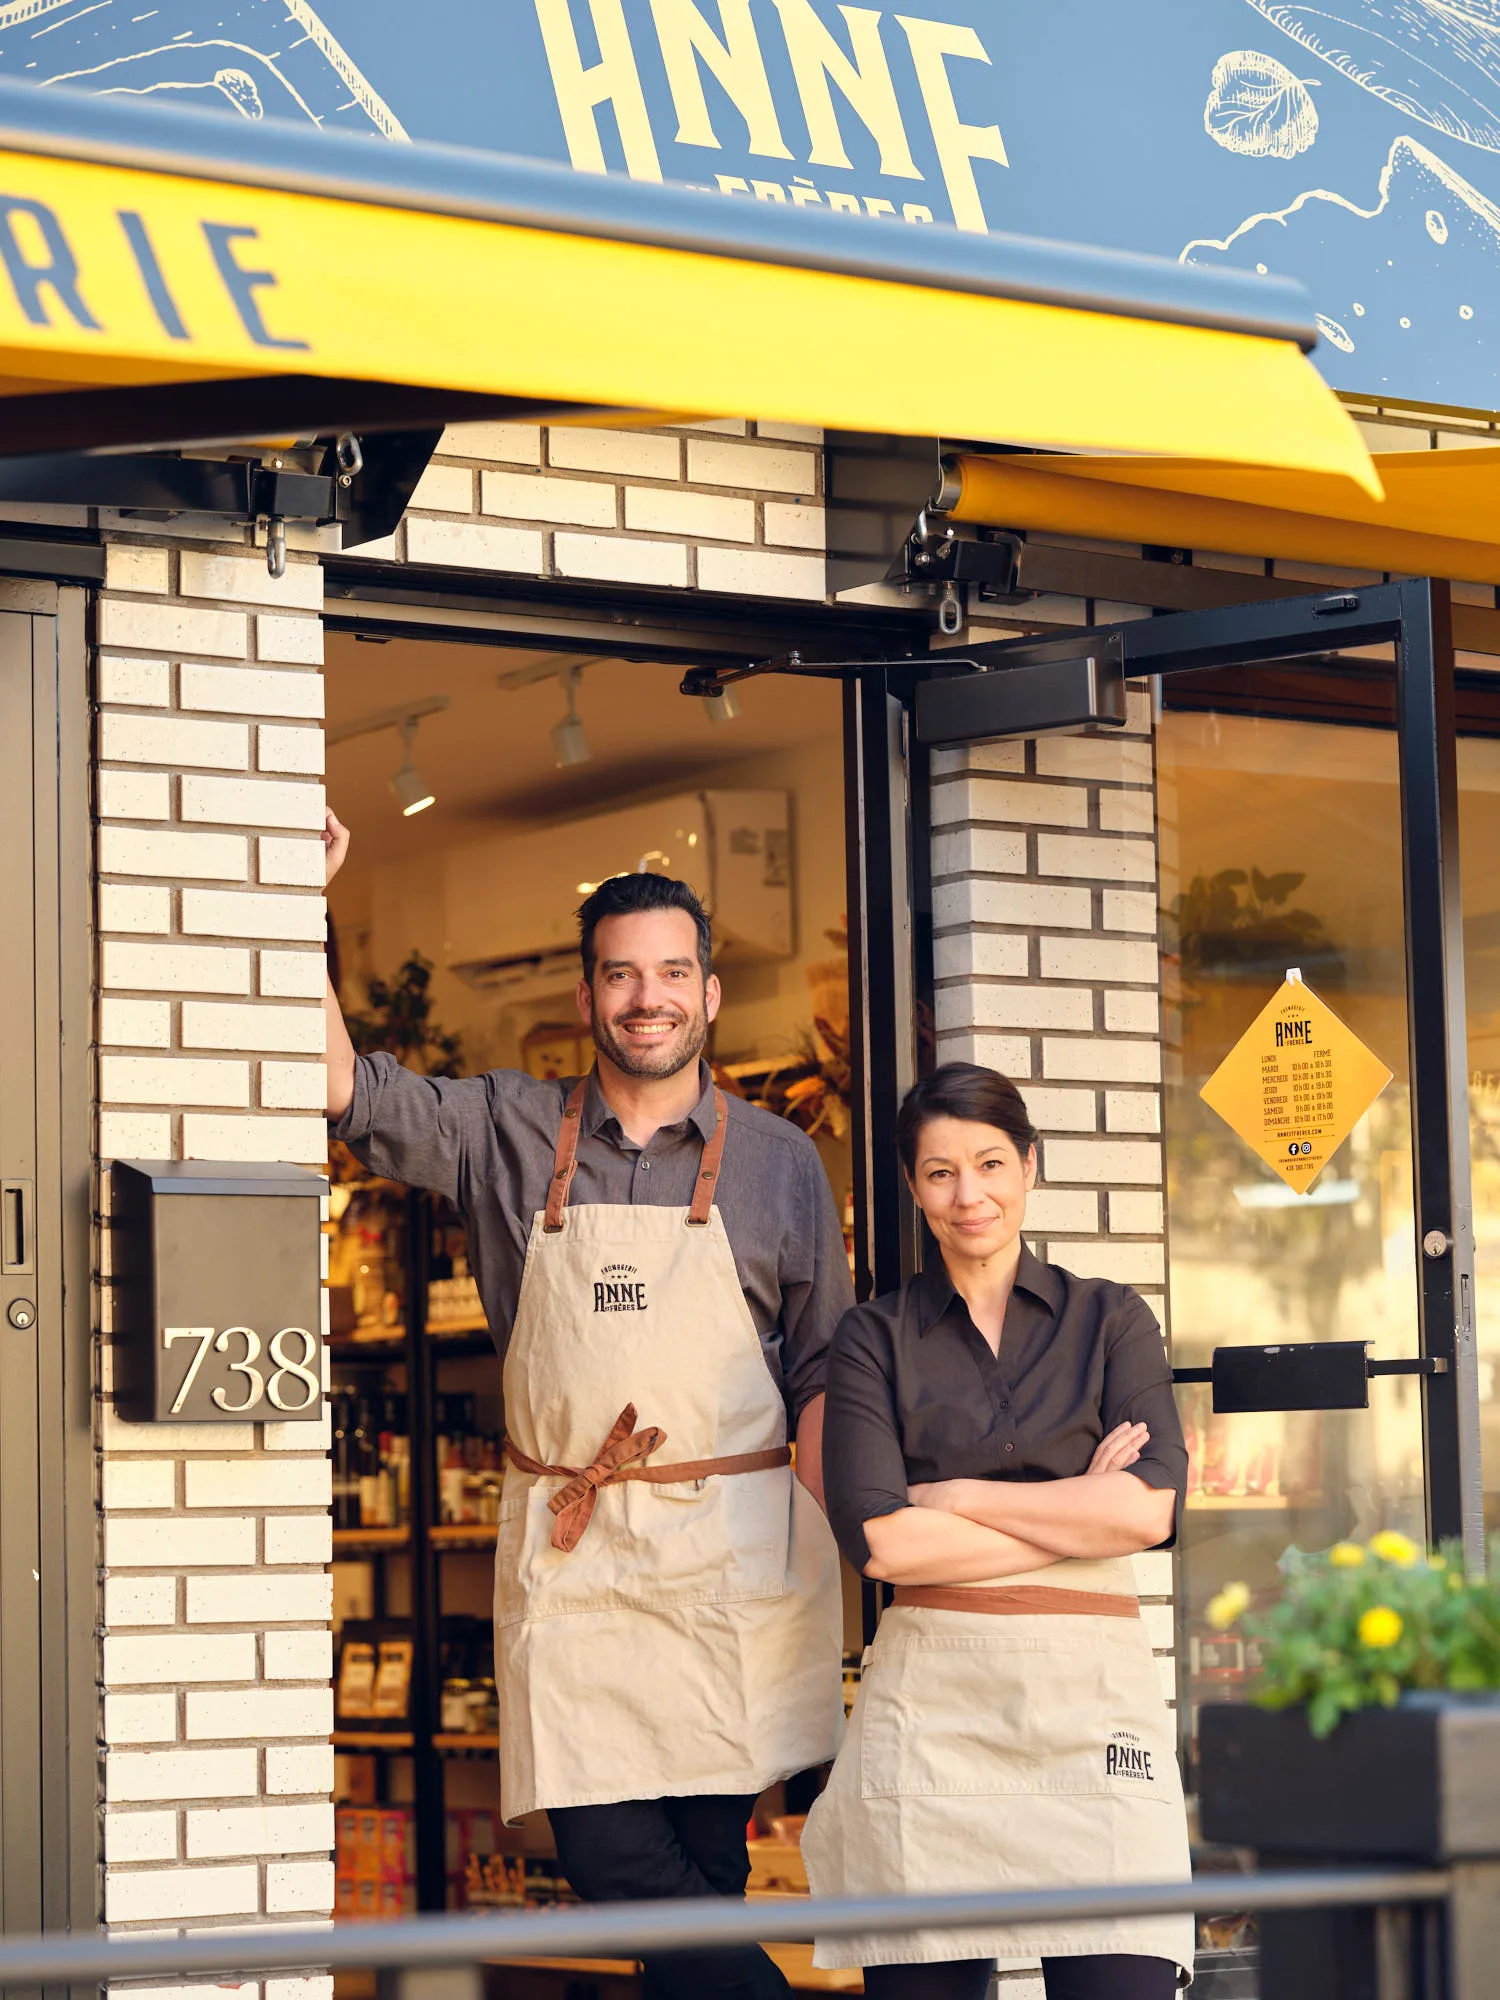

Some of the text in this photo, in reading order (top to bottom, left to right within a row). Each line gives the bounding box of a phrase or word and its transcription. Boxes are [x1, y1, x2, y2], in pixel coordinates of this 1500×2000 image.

[0, 194, 311, 350] RIE
[1275, 1020, 1312, 1047] ANNE
[1261, 1055, 1276, 1063] LUNDI
[1261, 1065, 1278, 1074] MARDI
[1262, 1074, 1288, 1084] MERCREDI
[1263, 1086, 1277, 1094] JEUDI
[1263, 1095, 1288, 1105] VENDREDI
[1263, 1106, 1283, 1115] SAMEDI
[1264, 1116, 1291, 1126] DIMANCHE
[600, 1264, 638, 1275] FROMAGERIE
[593, 1282, 648, 1312] ANNE
[161, 1327, 319, 1414] 738
[1106, 1744, 1154, 1781] ANNE
